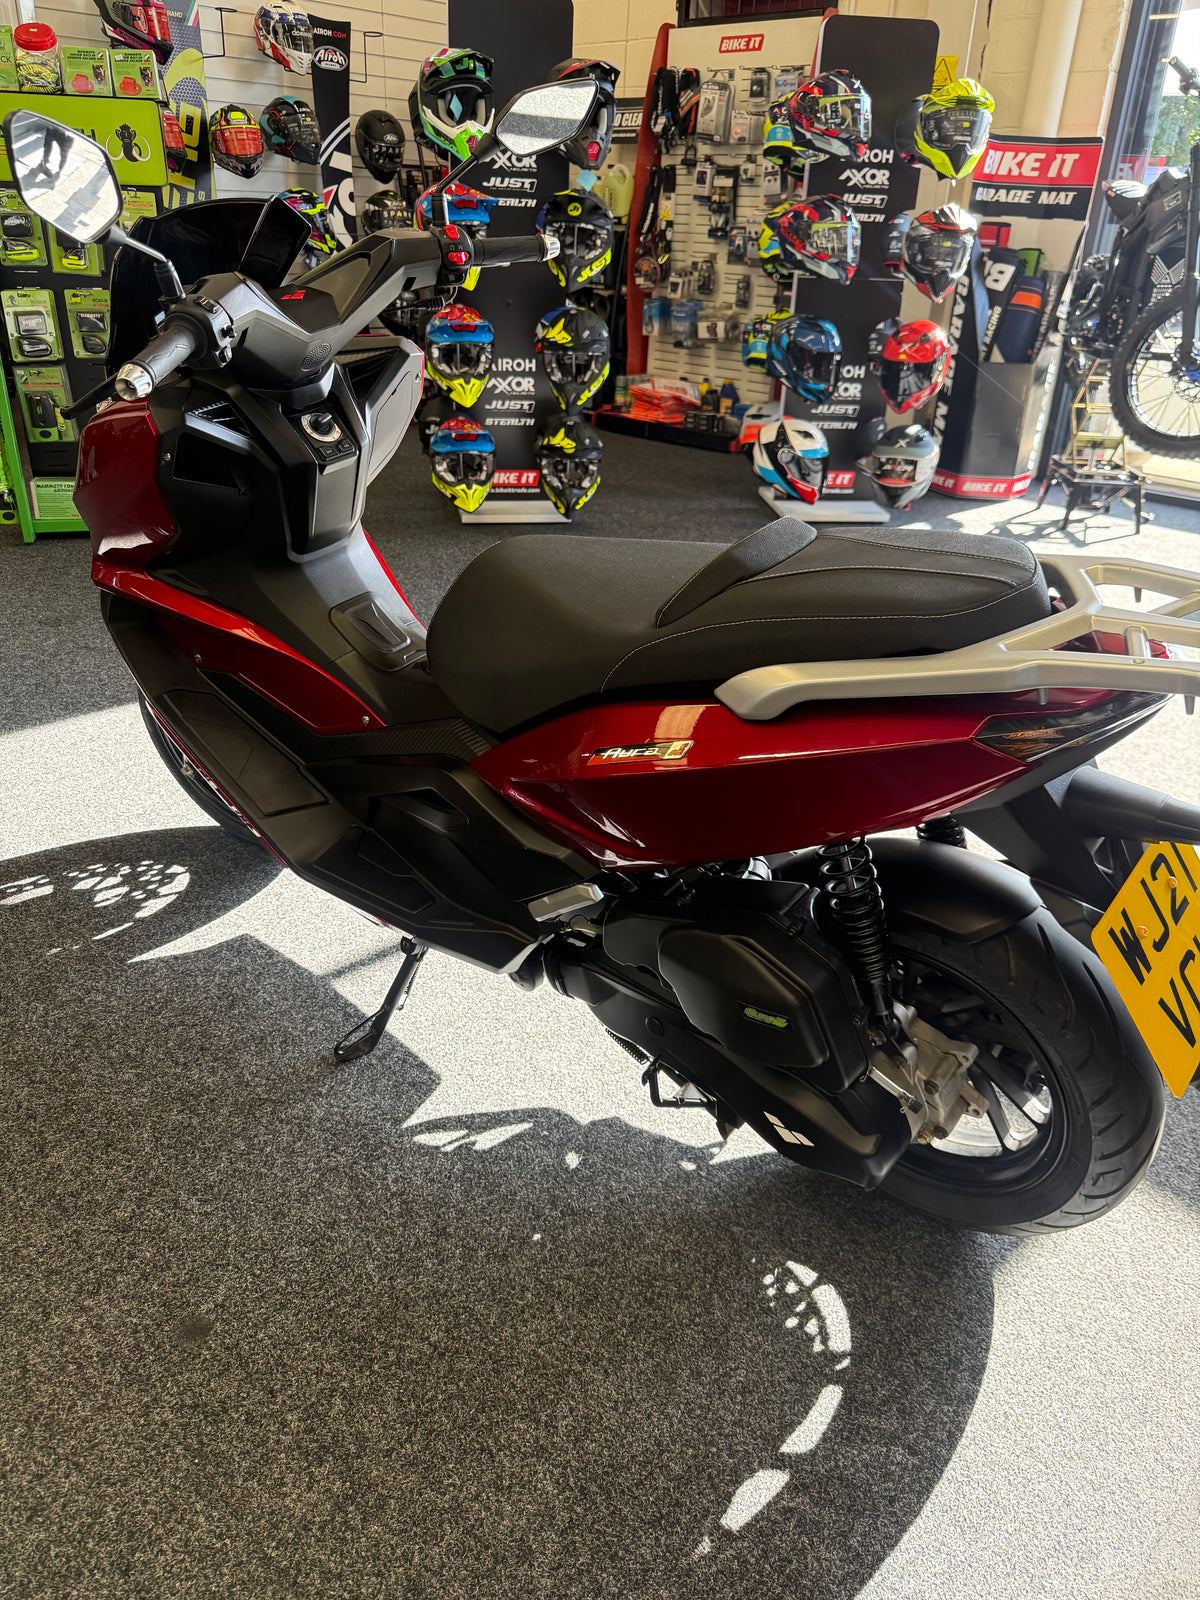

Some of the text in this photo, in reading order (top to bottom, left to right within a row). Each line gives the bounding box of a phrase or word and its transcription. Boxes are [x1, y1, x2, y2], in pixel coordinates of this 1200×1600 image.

[721, 37, 762, 51] BIKE IT
[622, 112, 643, 127] CLEA
[983, 149, 1080, 178] BIKE IT
[838, 167, 891, 187] AXOR
[497, 198, 538, 208] EALTH
[975, 187, 1078, 205] GARAGE MAT
[486, 376, 536, 394] AXOR
[484, 418, 536, 426] STEALTH
[932, 400, 950, 447] MA
[493, 472, 538, 484] IKE IT
[961, 480, 993, 493] BIKE
[992, 482, 1008, 494] IT
[1108, 841, 1198, 987] WJ21
